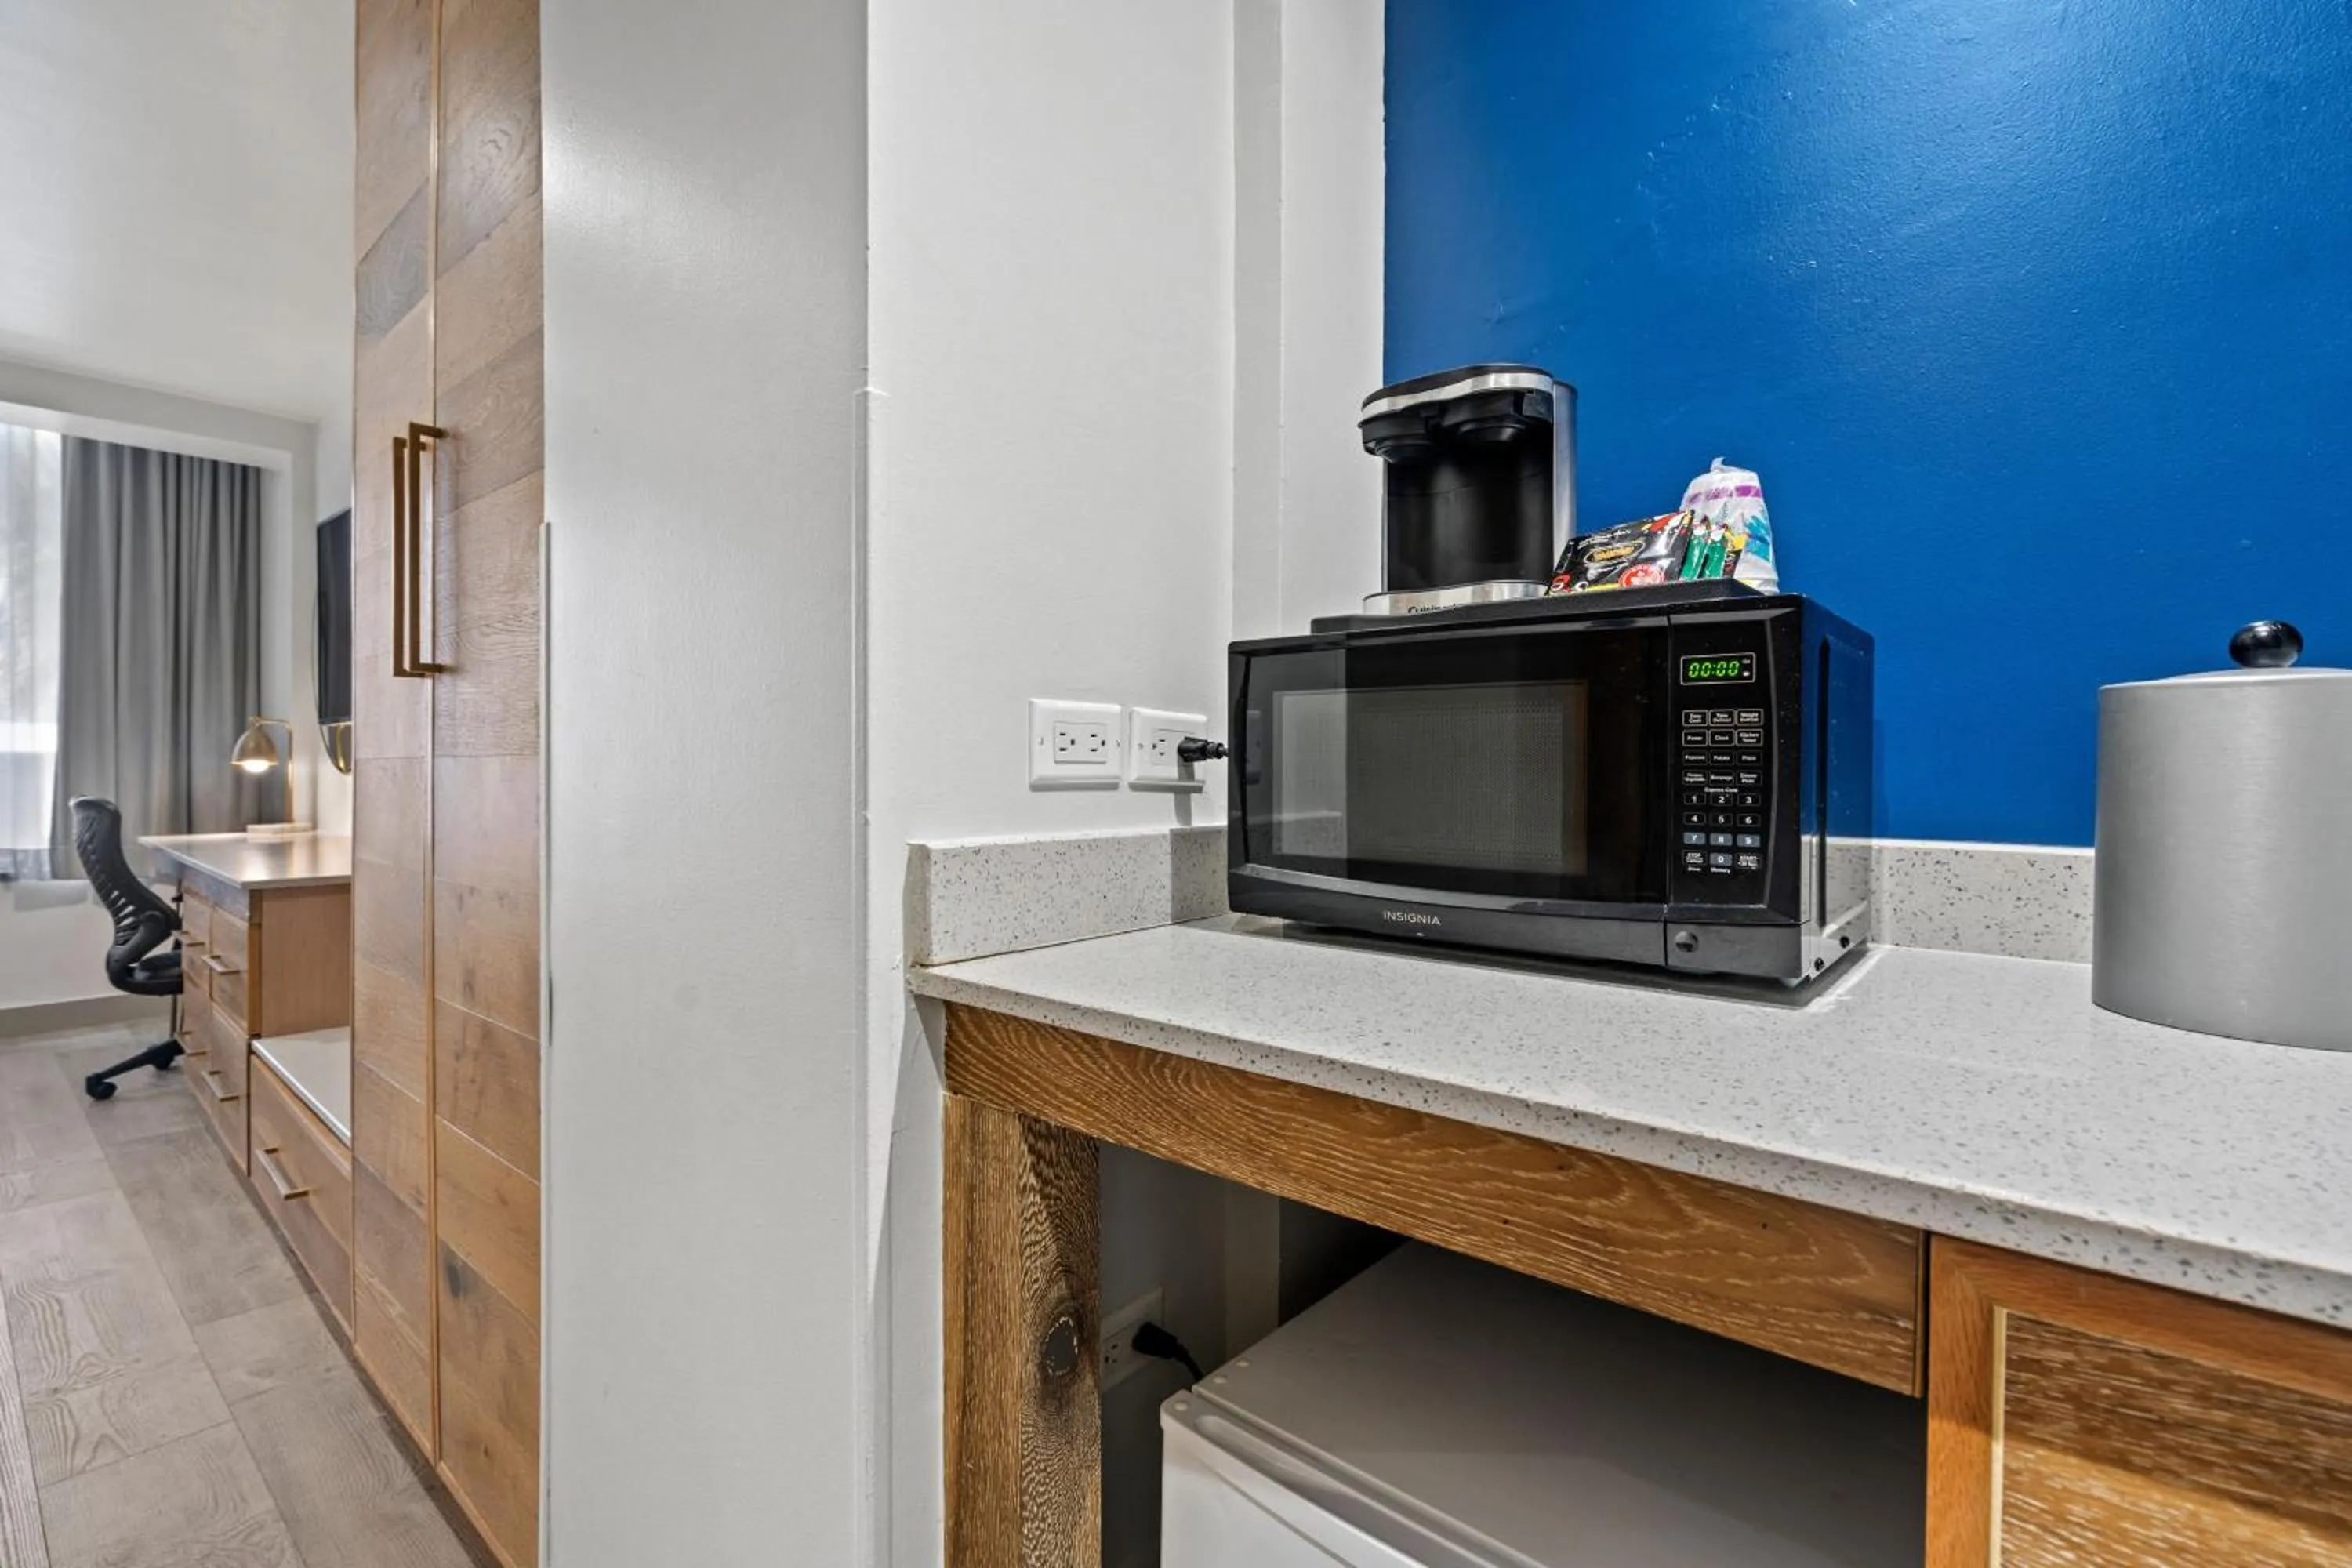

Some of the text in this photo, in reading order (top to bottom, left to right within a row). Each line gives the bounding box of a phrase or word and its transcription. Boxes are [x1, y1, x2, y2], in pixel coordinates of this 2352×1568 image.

[1688, 661, 1739, 677] 00:00
[1691, 795, 1697, 804] 1
[1382, 910, 1442, 925] INSIGNIA
